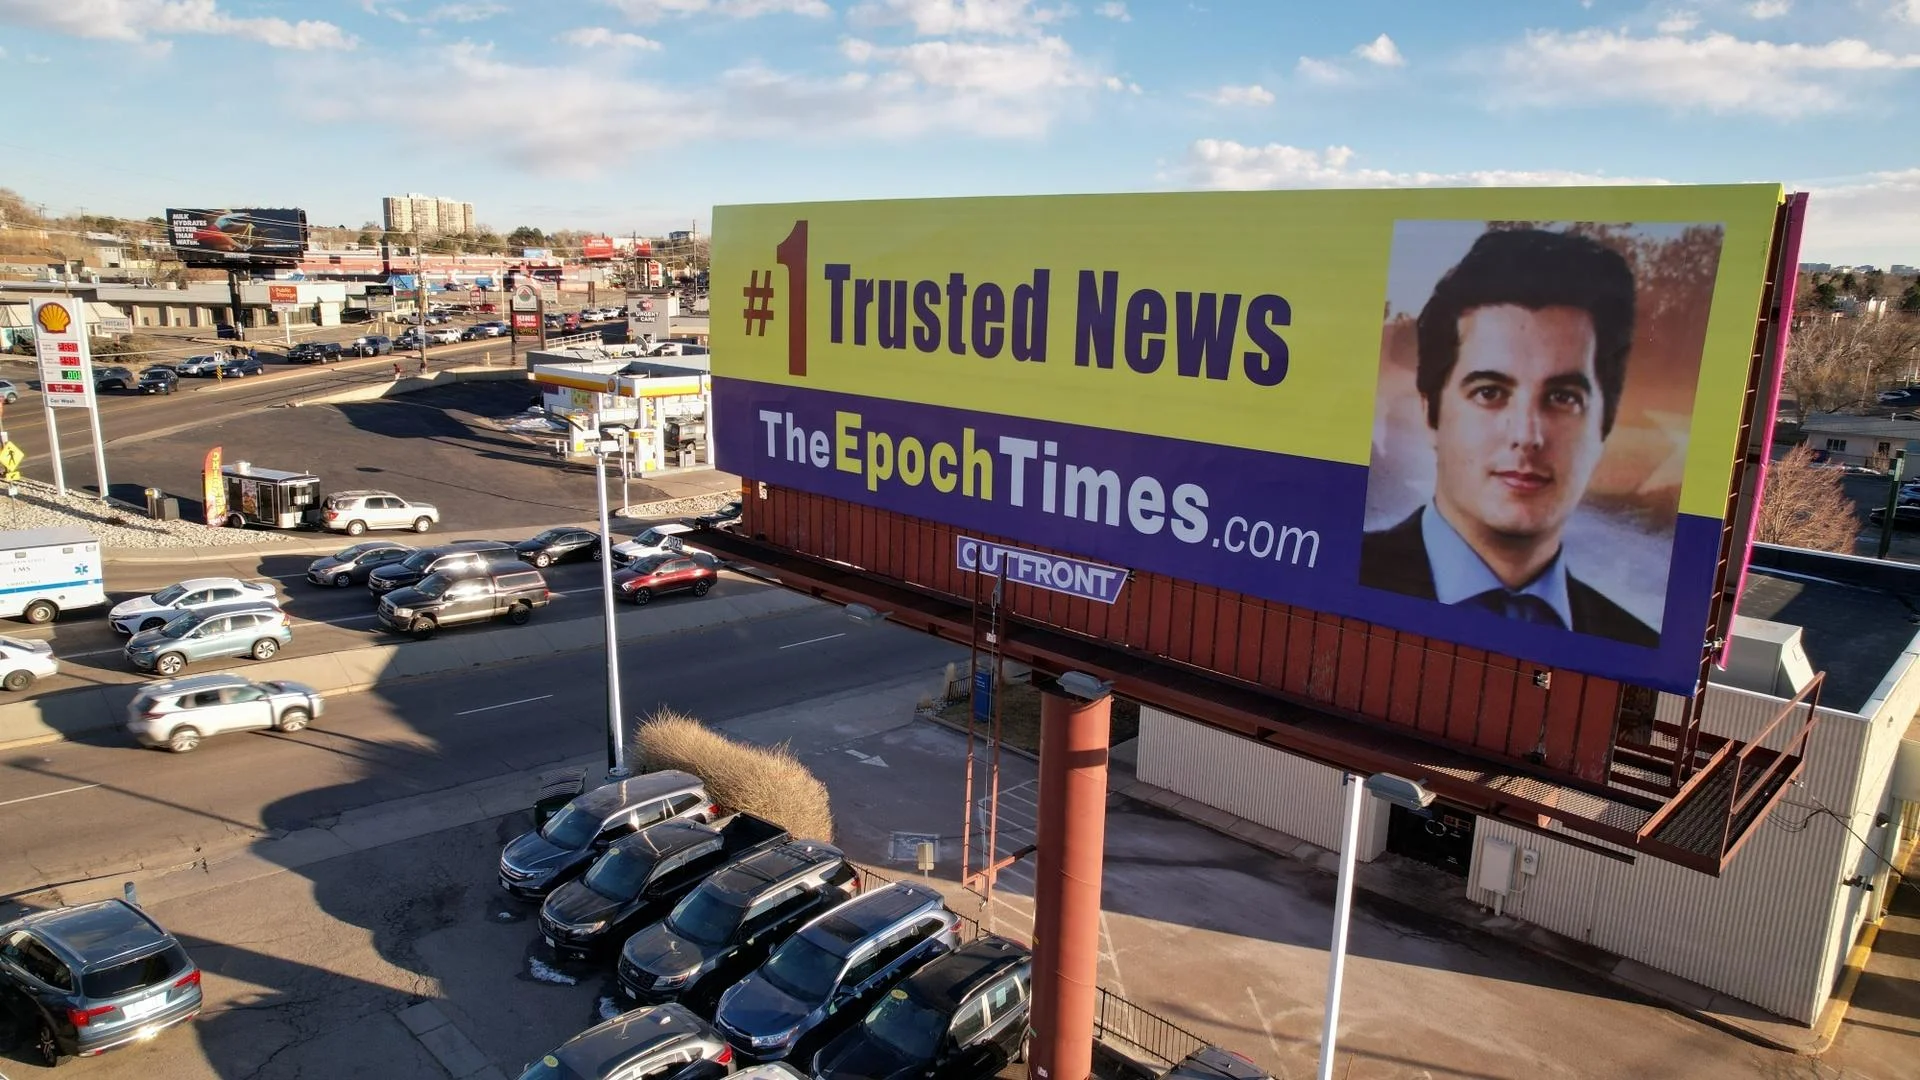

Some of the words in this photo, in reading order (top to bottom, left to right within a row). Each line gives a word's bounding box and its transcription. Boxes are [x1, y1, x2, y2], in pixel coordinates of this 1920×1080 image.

[516, 314, 536, 322] KING
[743, 220, 808, 377] #1
[824, 263, 1050, 363] Trusted
[1075, 269, 1292, 387] News
[759, 409, 1320, 568] TheEpochTimes.com
[962, 541, 1116, 597] OUTFRONT
